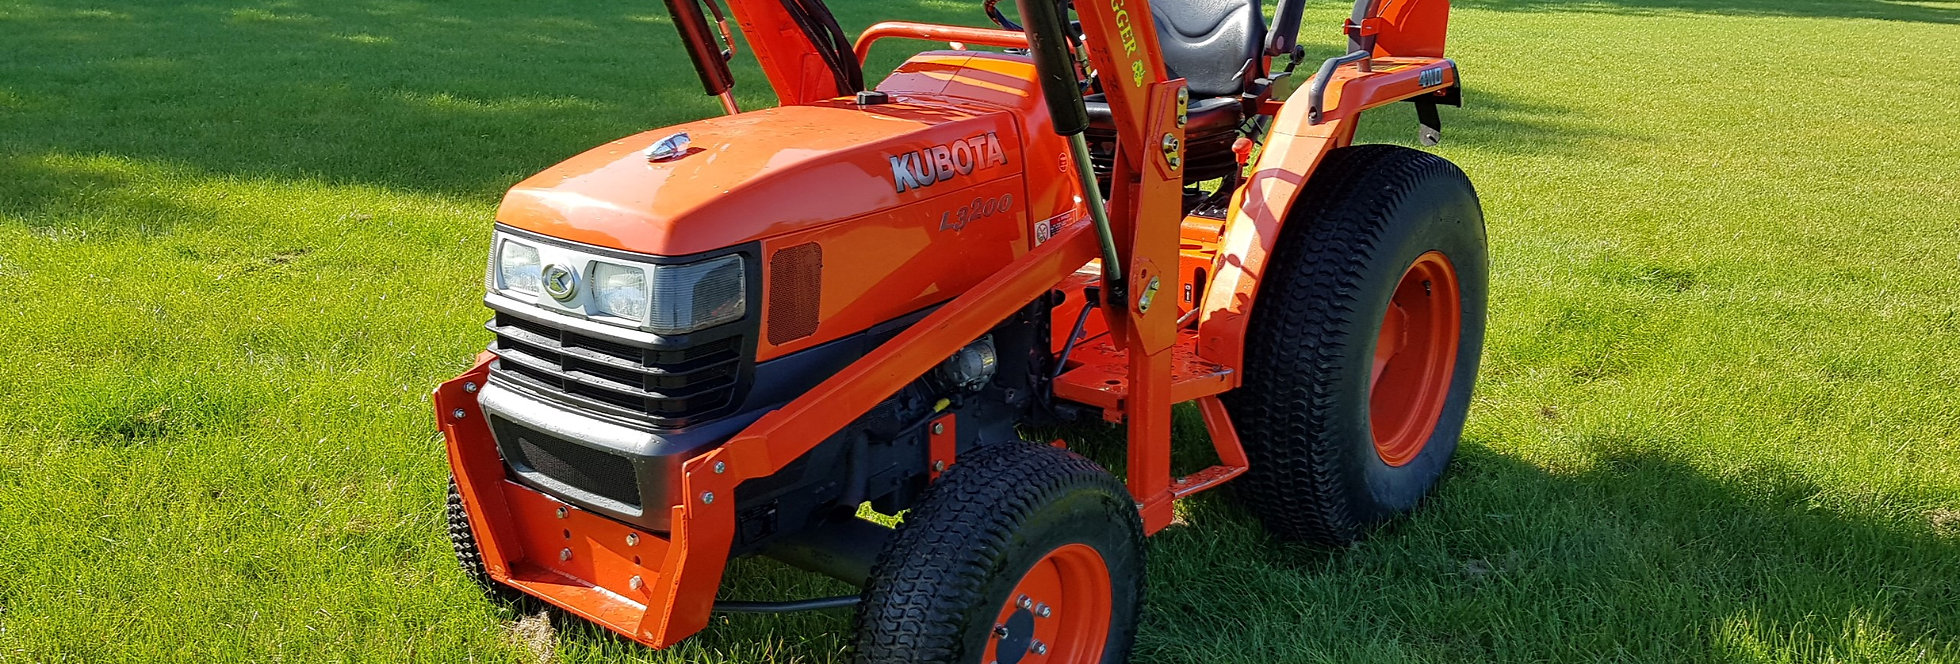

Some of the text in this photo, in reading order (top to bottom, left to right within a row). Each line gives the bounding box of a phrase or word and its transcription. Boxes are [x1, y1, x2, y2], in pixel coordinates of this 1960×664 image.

[1419, 67, 1443, 87] 4WD
[889, 132, 1008, 193] KUBOTA
[939, 193, 1013, 232] L3200
